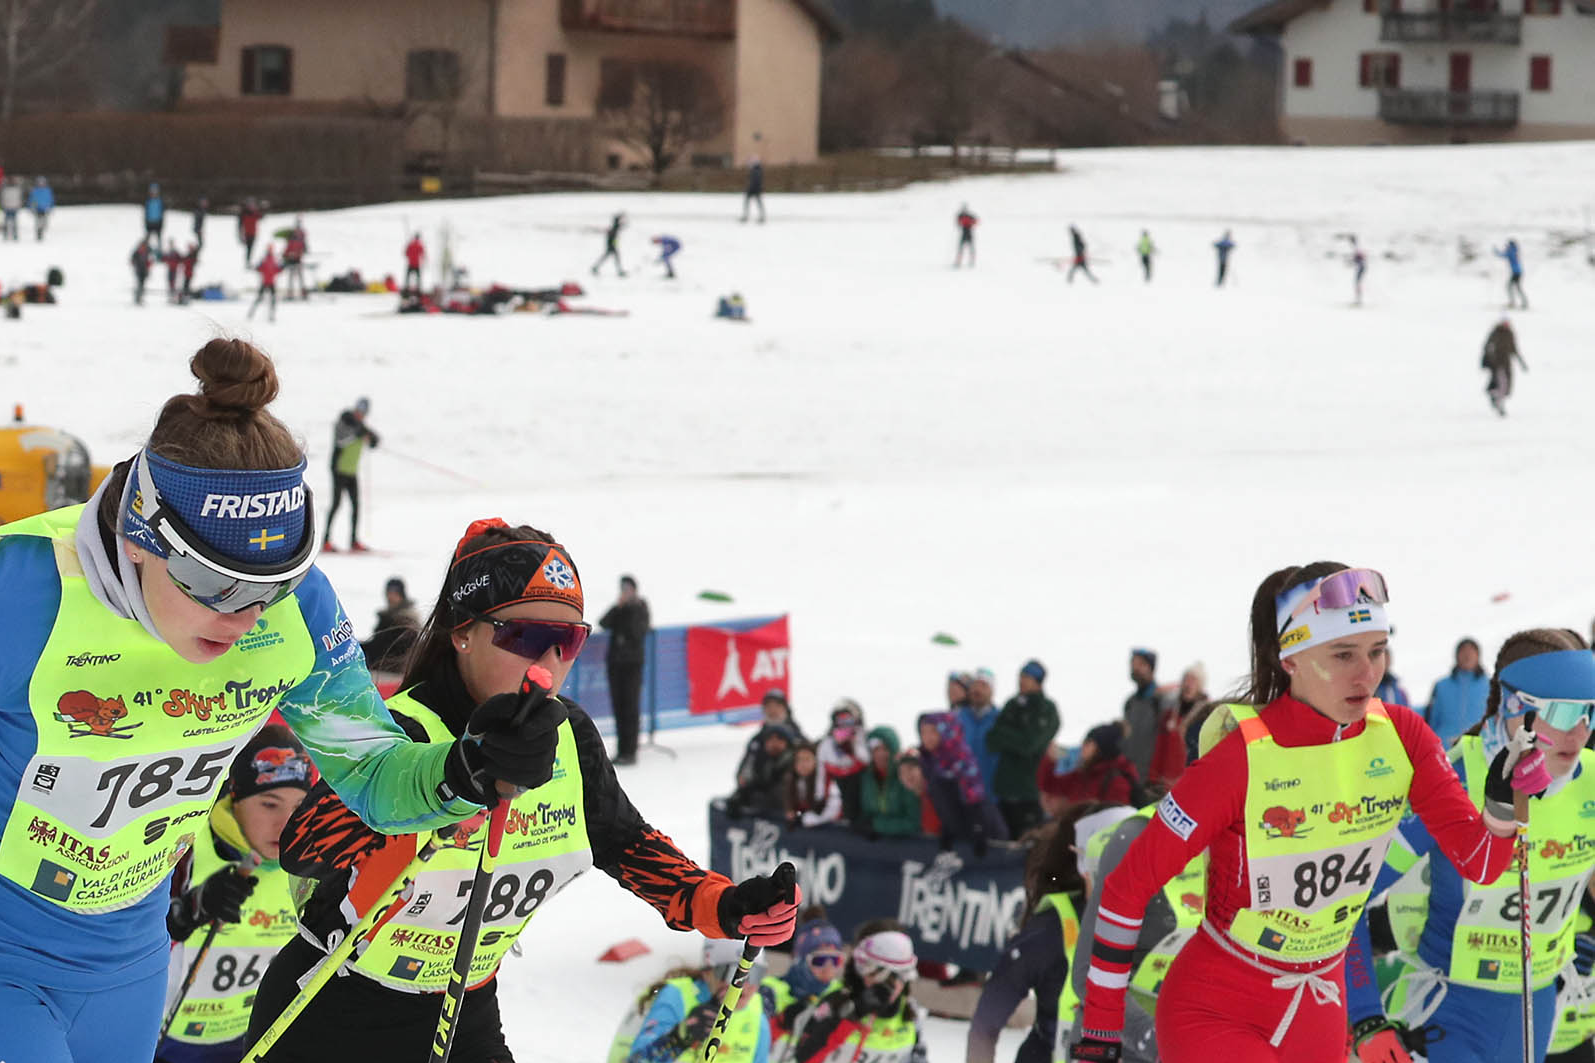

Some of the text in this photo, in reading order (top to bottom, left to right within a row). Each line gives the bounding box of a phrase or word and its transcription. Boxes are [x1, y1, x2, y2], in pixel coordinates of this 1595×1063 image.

[240, 637, 285, 652] cembra
[66, 652, 122, 668] TRENTINO
[183, 724, 230, 738] CASTELLO
[90, 746, 236, 828] 785
[55, 847, 131, 873] ASSICURAZIONI
[58, 831, 112, 865] ITAS
[76, 860, 165, 900] CASSA RURALE
[81, 847, 169, 890] VAL DI FIEMME
[1294, 847, 1372, 908] 884
[446, 869, 554, 926] 788
[1277, 908, 1311, 928] ITAS
[413, 933, 456, 949] ITAS
[428, 958, 446, 969] VAL
[430, 968, 462, 1058] LEKI
